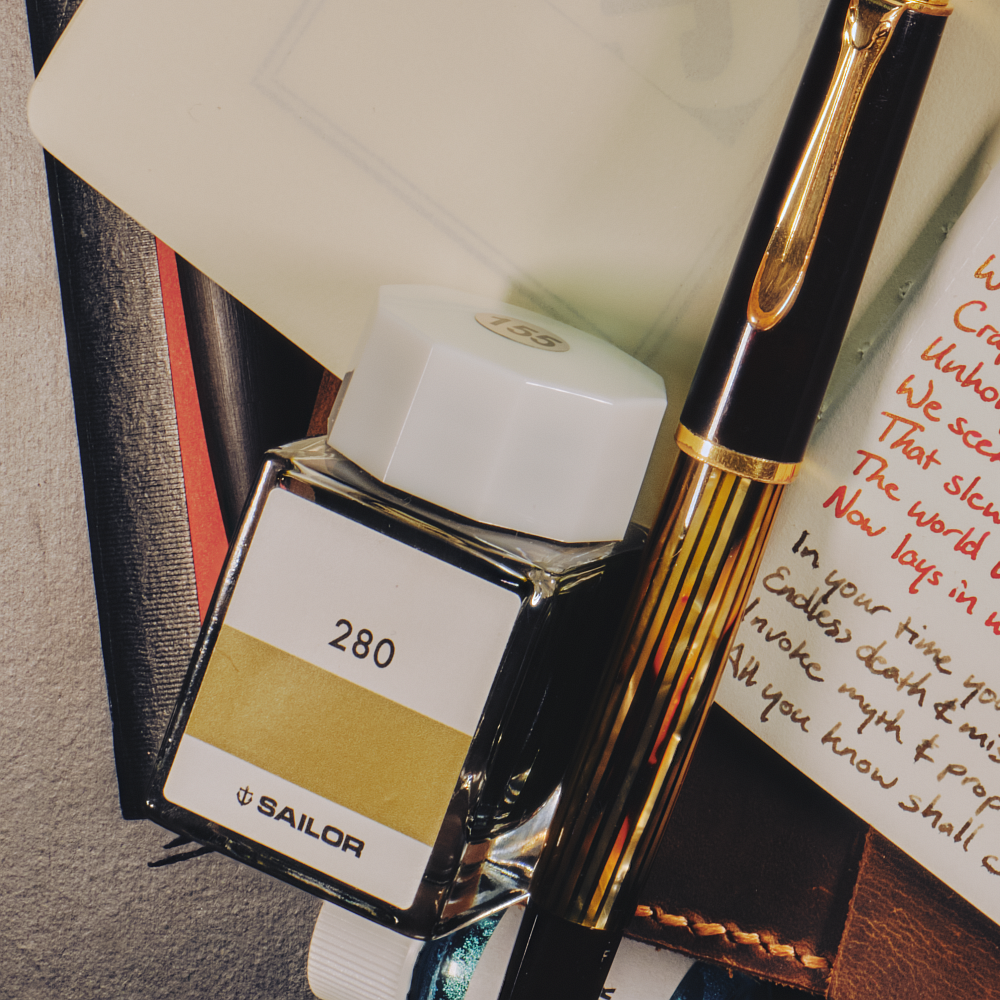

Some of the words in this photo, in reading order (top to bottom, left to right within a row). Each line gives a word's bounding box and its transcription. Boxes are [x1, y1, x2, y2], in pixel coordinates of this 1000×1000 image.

[489, 316, 563, 347] 155
[878, 411, 942, 471] That
[896, 373, 943, 423] We
[822, 484, 887, 537] Now
[890, 532, 944, 595] lays
[948, 579, 978, 616] in
[852, 449, 901, 502] The
[907, 500, 991, 561] world
[329, 619, 395, 668] 280
[762, 565, 852, 644] Endless
[855, 640, 932, 708] death
[791, 529, 820, 570] In
[824, 568, 893, 617] your
[894, 616, 953, 676] time
[739, 597, 825, 683] Invoke
[837, 683, 905, 745] myth
[759, 683, 811, 733] you
[821, 721, 899, 790] know
[897, 794, 985, 852] shall
[256, 795, 366, 859] SAILOR
